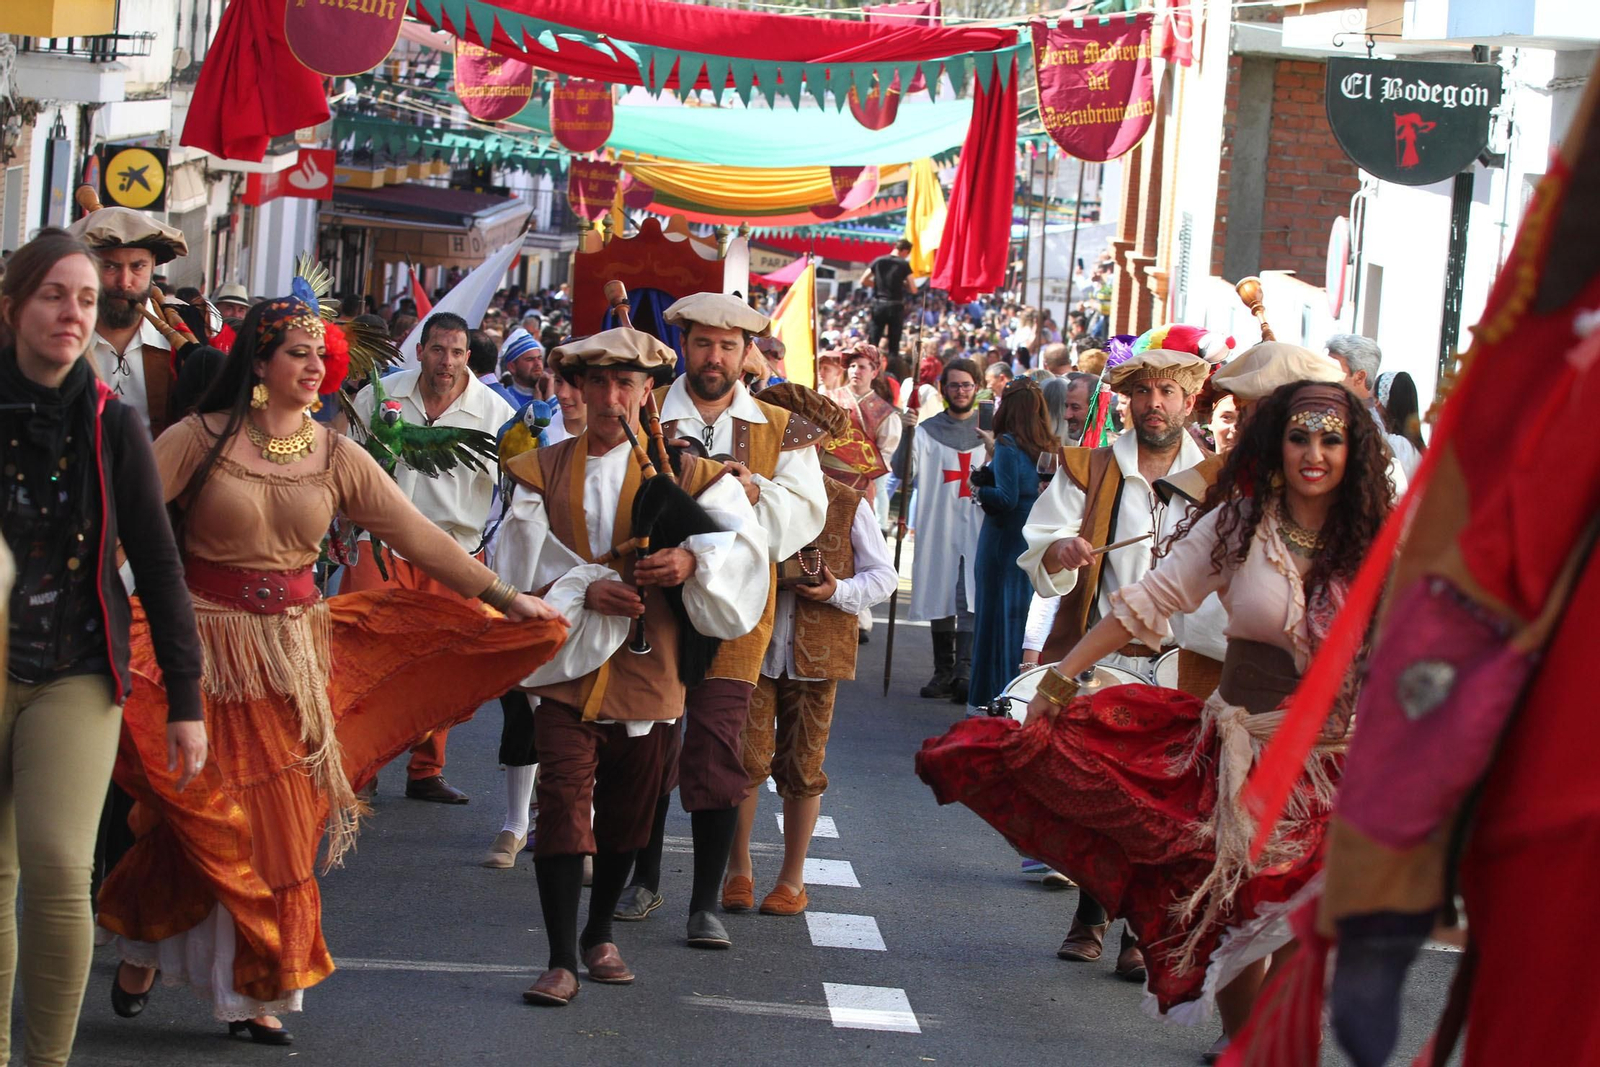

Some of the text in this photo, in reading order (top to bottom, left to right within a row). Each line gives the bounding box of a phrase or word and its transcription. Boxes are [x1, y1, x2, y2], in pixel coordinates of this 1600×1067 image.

[1038, 38, 1152, 69] Feria Medieval
[1086, 69, 1110, 91] del
[1340, 72, 1489, 109] El Bodegón
[1045, 97, 1154, 129] Descubrimiento
